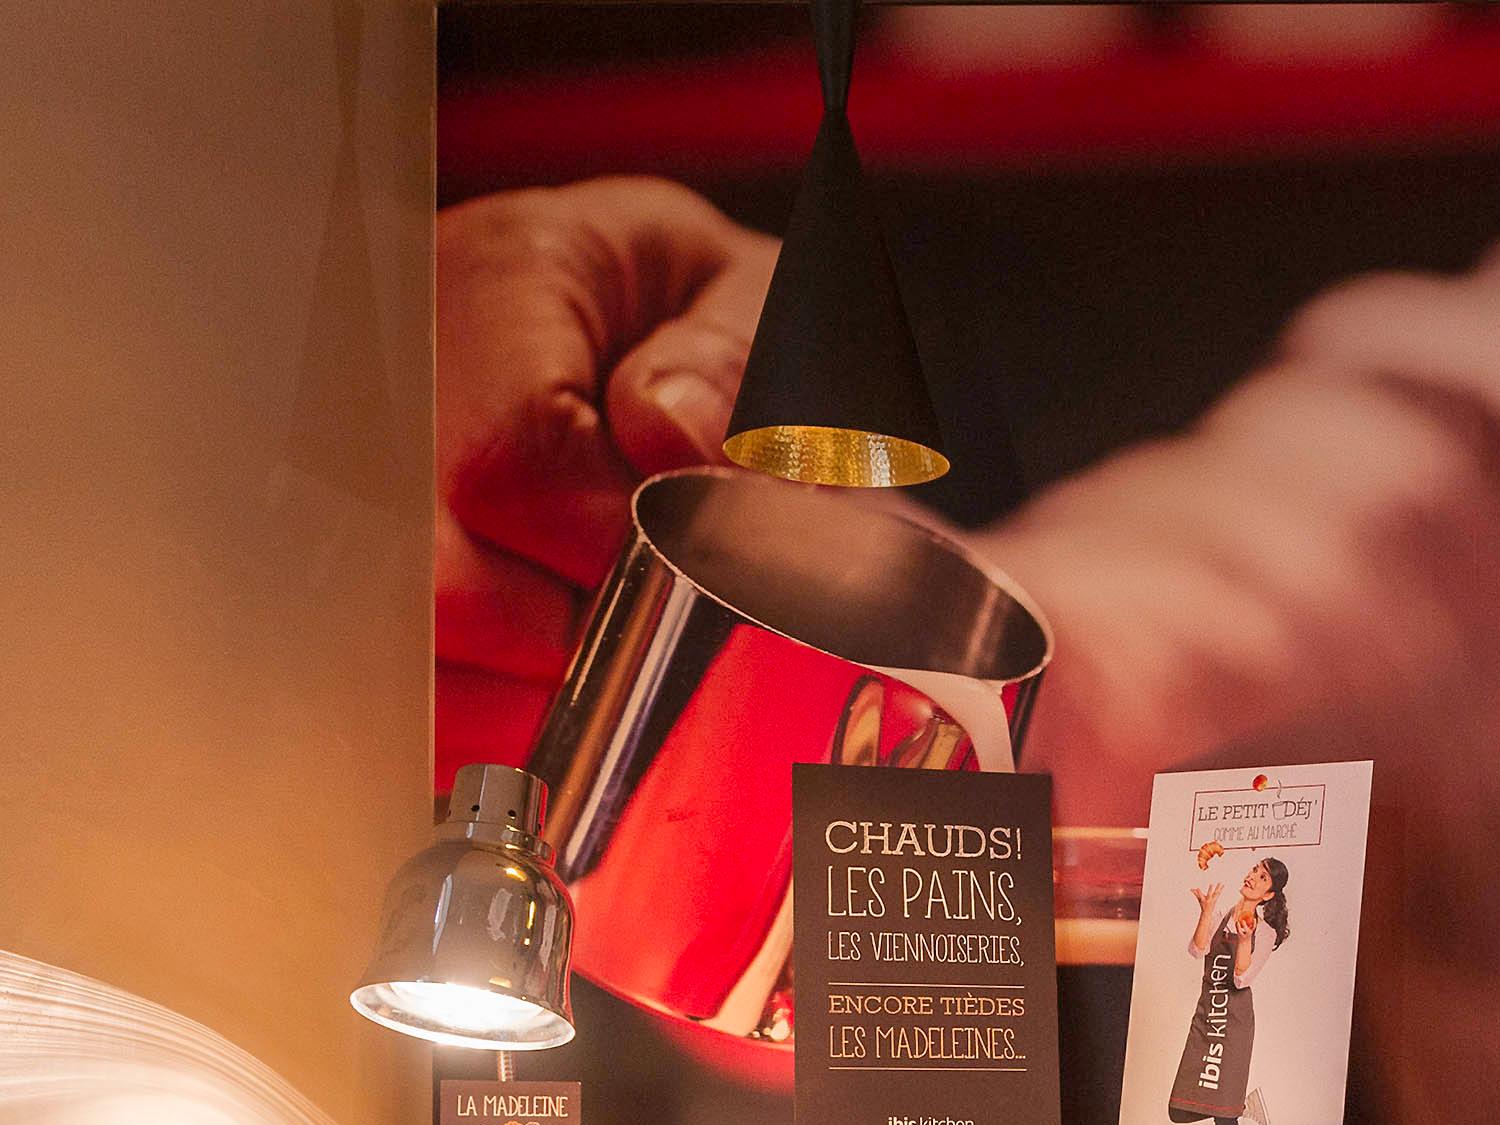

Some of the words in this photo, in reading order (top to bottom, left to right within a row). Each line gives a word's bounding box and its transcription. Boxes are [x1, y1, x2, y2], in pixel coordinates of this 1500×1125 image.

[1198, 806, 1218, 821] LE
[1222, 803, 1269, 820] PETIT
[825, 821, 1022, 860] CHAUDS!
[1214, 826, 1245, 842] COMME
[1247, 826, 1259, 840] AU
[1261, 823, 1298, 840] MARCHÉ
[827, 866, 885, 918] LES
[902, 868, 1022, 926] PAINS,
[827, 932, 861, 961] LES
[870, 933, 1025, 967] VIENNOISERIES,
[828, 995, 935, 1016] ENCORE
[939, 990, 1025, 1017] TIÈDES
[1206, 953, 1232, 1038] kitchen
[830, 1026, 868, 1059] LES
[1199, 1043, 1224, 1090] ibis
[457, 1095, 478, 1116] LA
[483, 1095, 568, 1117] MADELEINE
